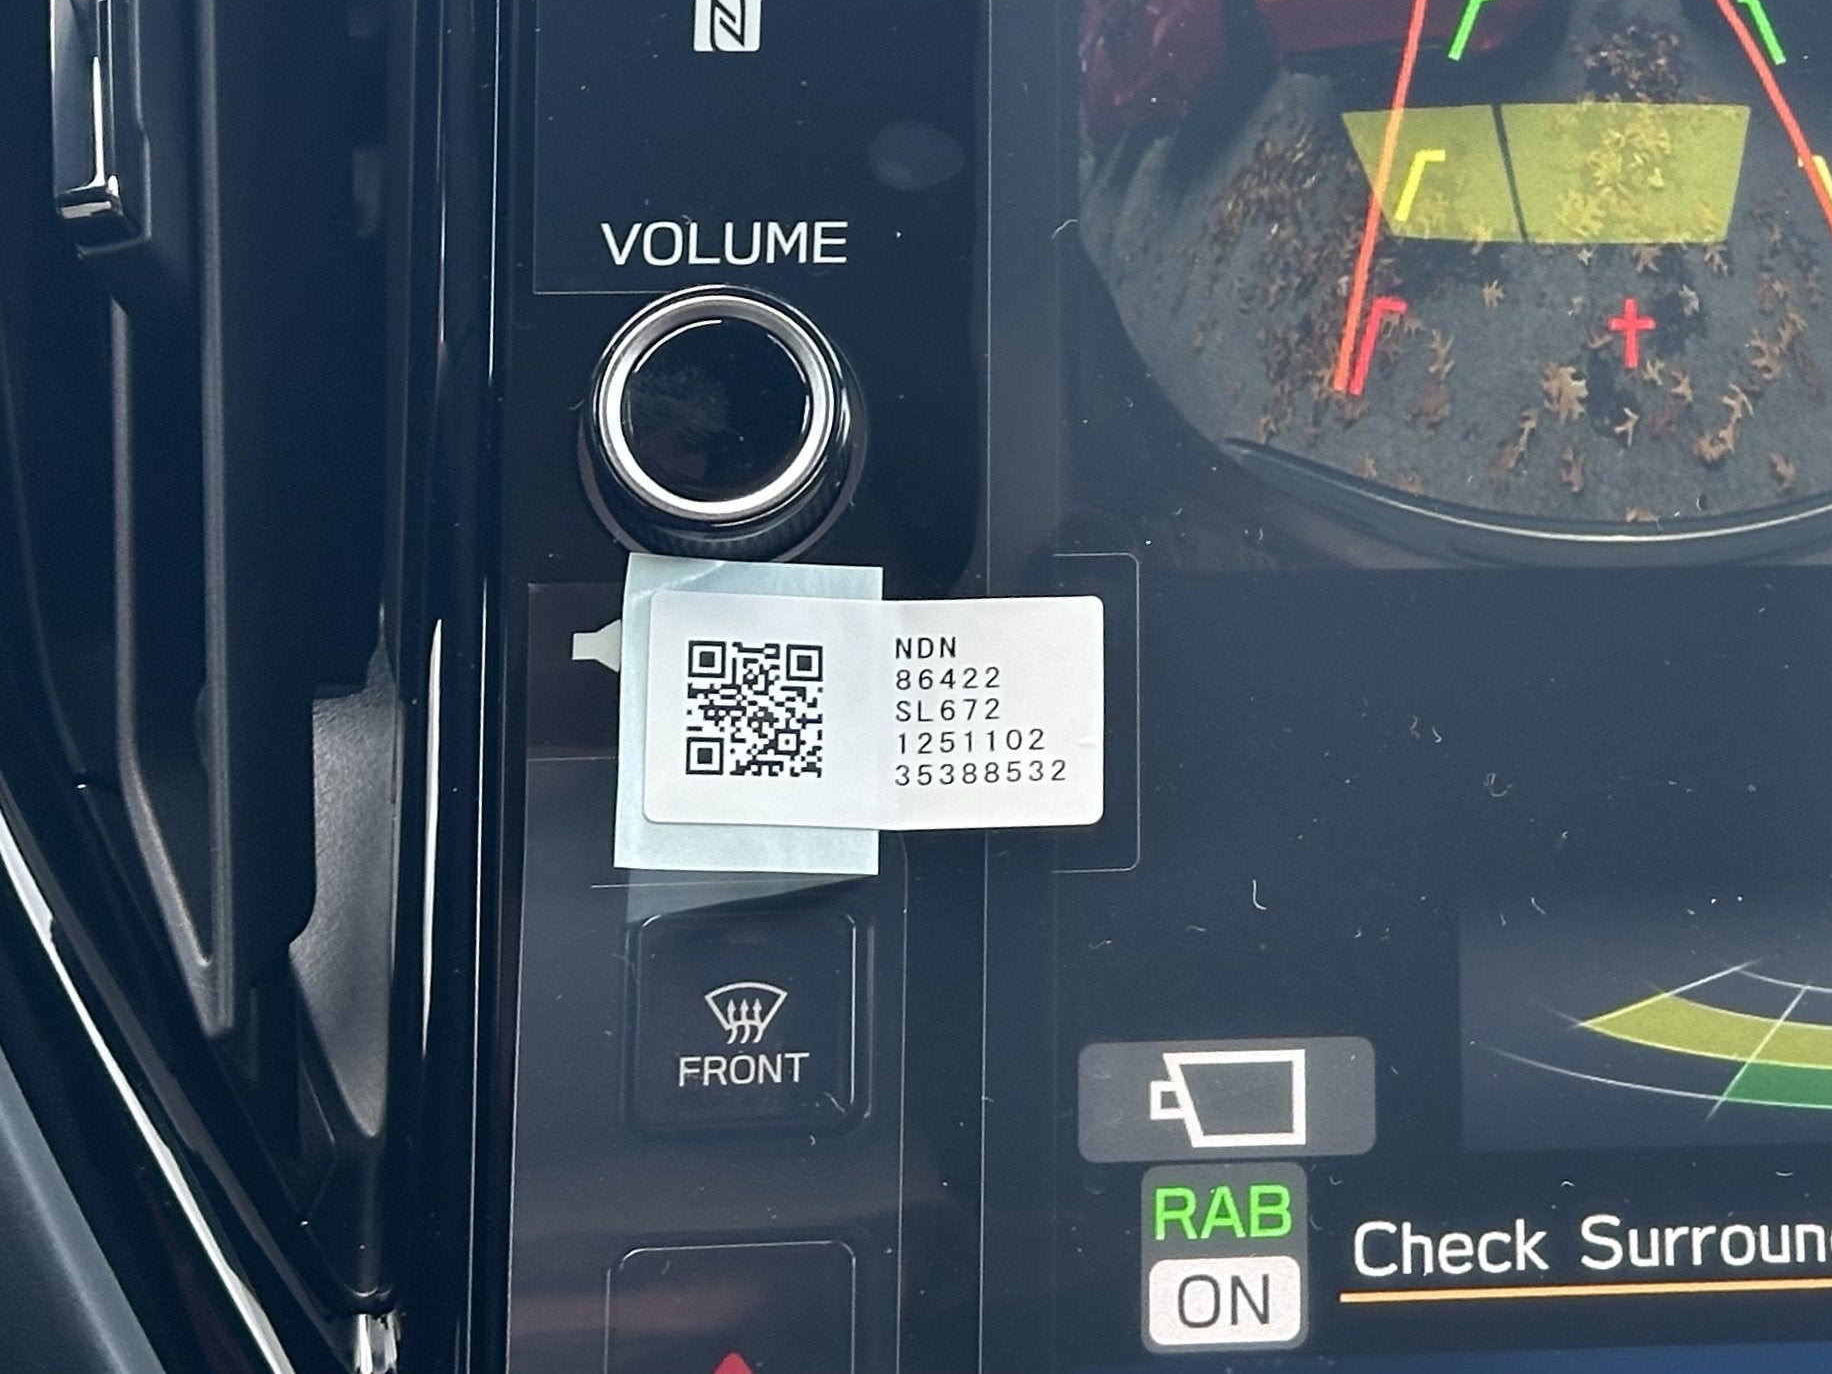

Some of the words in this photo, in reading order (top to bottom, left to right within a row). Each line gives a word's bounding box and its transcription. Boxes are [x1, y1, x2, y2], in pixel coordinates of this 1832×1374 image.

[601, 221, 849, 267] VOLUME
[894, 636, 957, 660] NDN
[894, 666, 1002, 691] 86422
[894, 699, 1002, 723] SL672
[898, 728, 1046, 755] 1251102
[894, 760, 1068, 787] 35388532
[677, 1052, 810, 1088] FRONT
[1153, 1183, 1293, 1242] RAB
[1352, 1218, 1549, 1277] Check
[1176, 1273, 1273, 1330] ON
